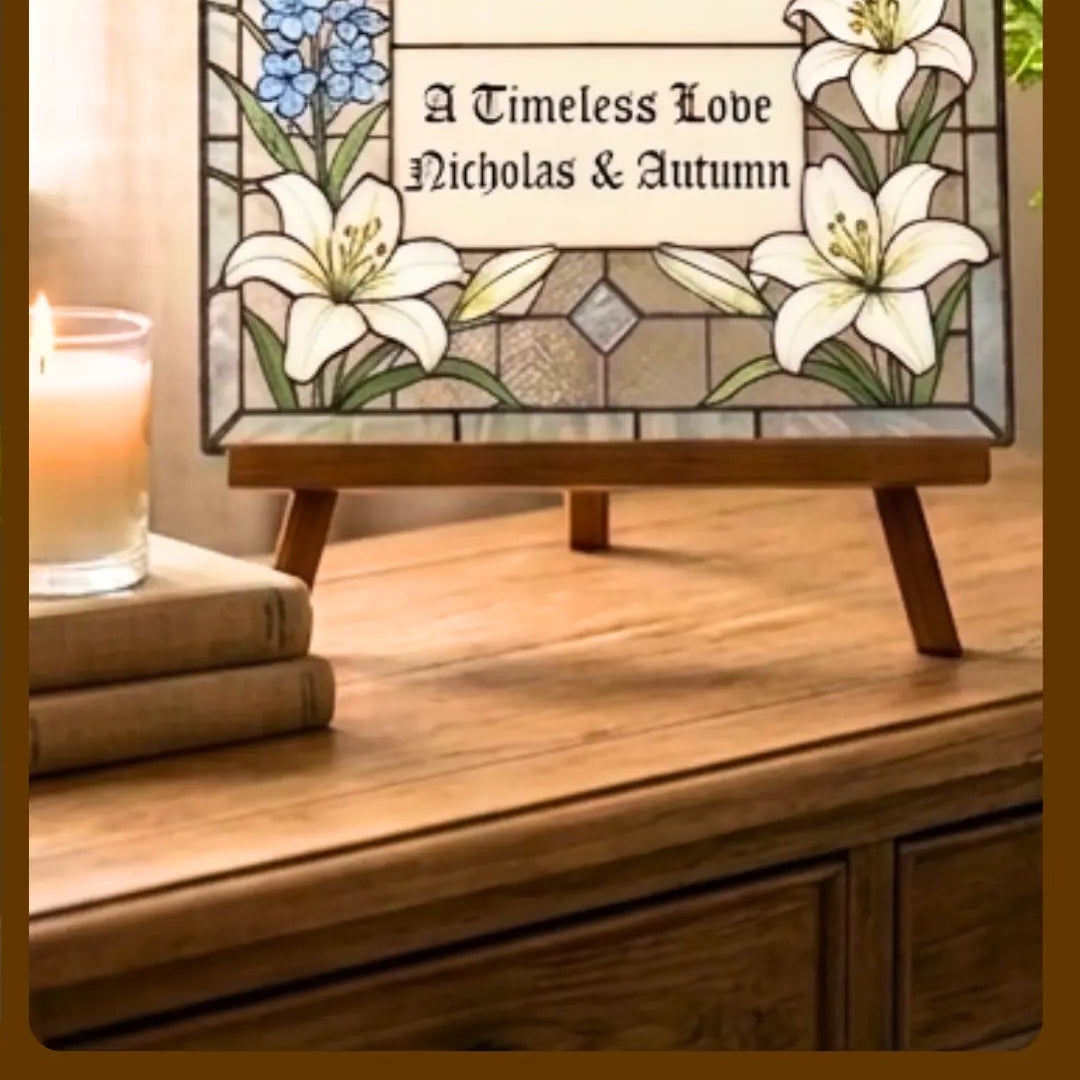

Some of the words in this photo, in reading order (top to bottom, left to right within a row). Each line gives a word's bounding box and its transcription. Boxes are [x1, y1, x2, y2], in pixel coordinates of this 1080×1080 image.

[424, 82, 457, 123] A
[471, 83, 657, 125] Timeless
[670, 81, 771, 124] Love
[404, 149, 575, 195] Nicholas
[591, 149, 623, 190] &
[637, 149, 790, 190] Autumn
